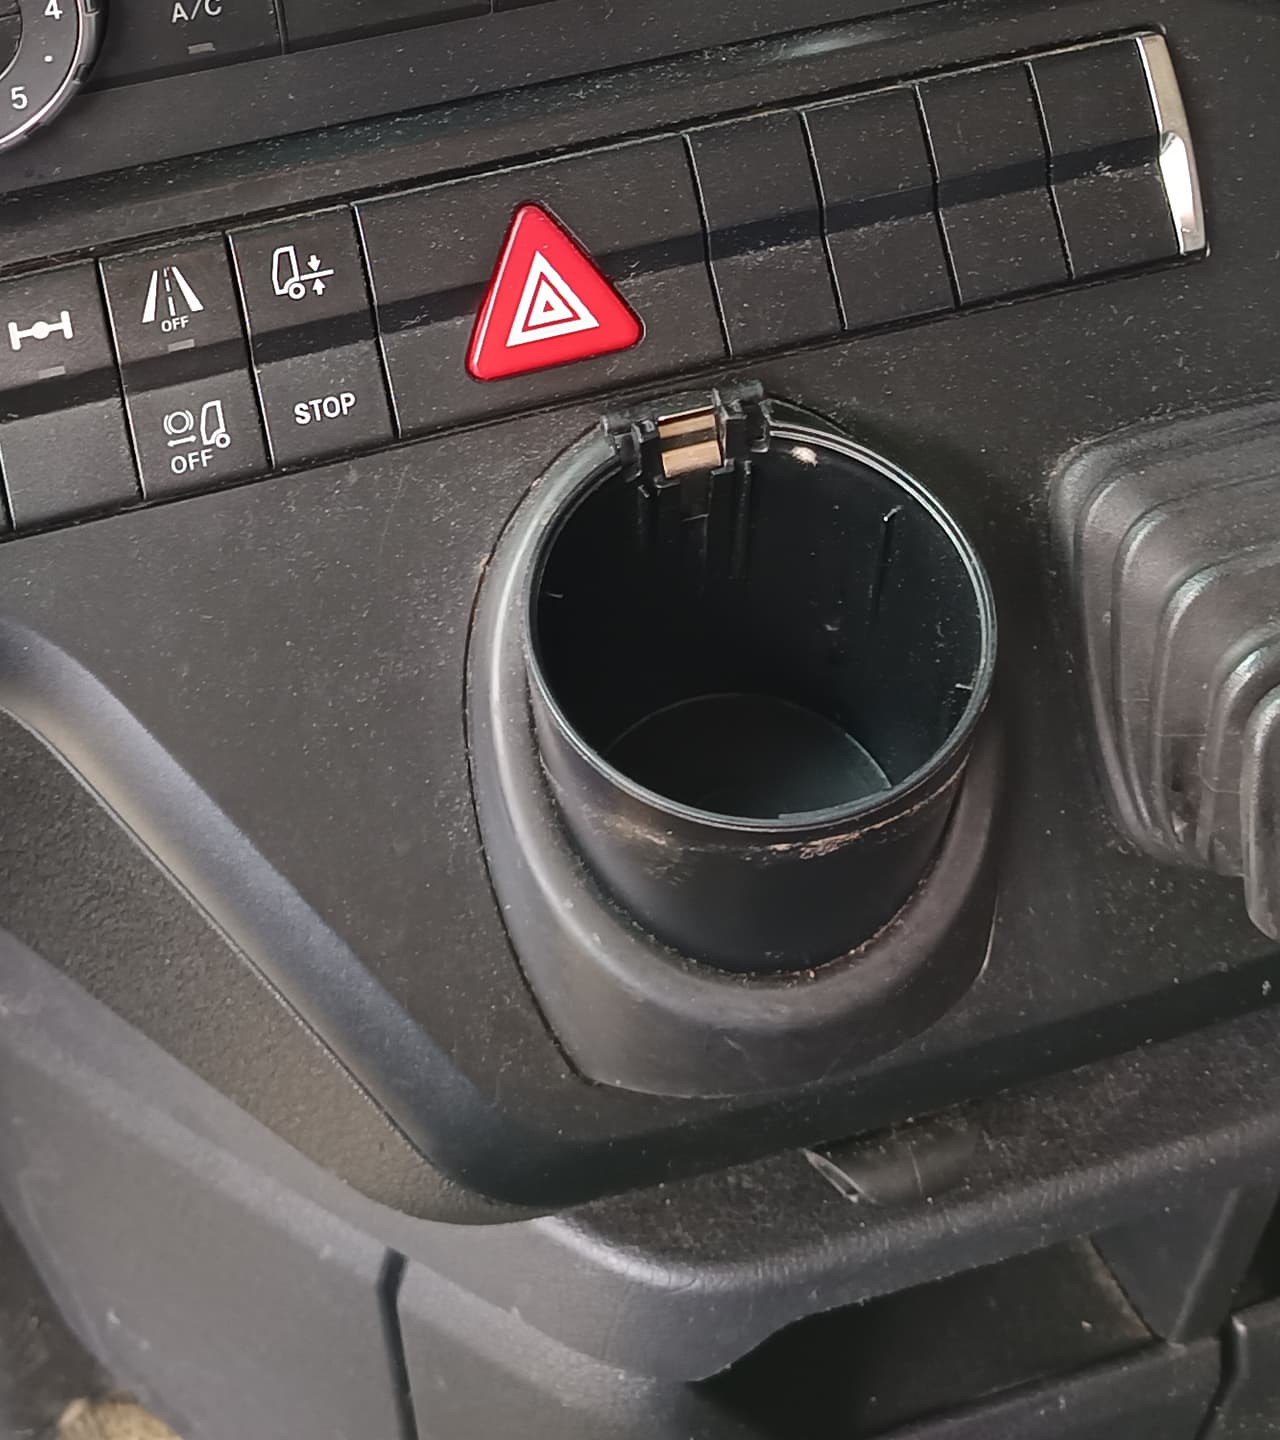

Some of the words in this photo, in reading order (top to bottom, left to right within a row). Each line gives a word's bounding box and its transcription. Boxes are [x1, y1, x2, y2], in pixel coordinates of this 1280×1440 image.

[11, 86, 28, 109] 5
[161, 315, 189, 332] OFF
[294, 392, 356, 425] STOP
[170, 448, 213, 474] OFF
